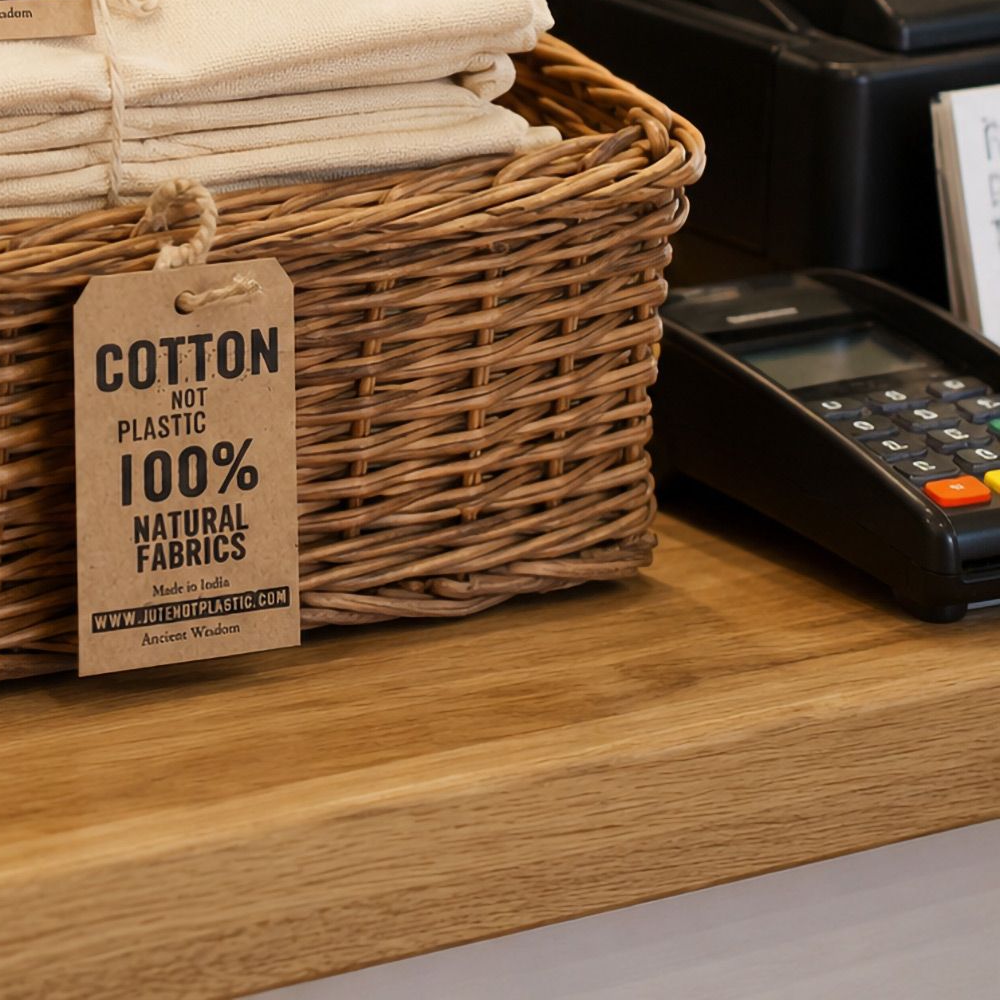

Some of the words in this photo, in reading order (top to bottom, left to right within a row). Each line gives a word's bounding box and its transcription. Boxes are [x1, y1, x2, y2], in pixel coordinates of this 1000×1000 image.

[95, 326, 279, 393] COTTON
[171, 387, 208, 410] NOT
[118, 410, 206, 443] PLASTIC
[121, 437, 259, 506] 100%
[133, 503, 249, 544] NATURAL
[136, 532, 247, 573] FABRICS
